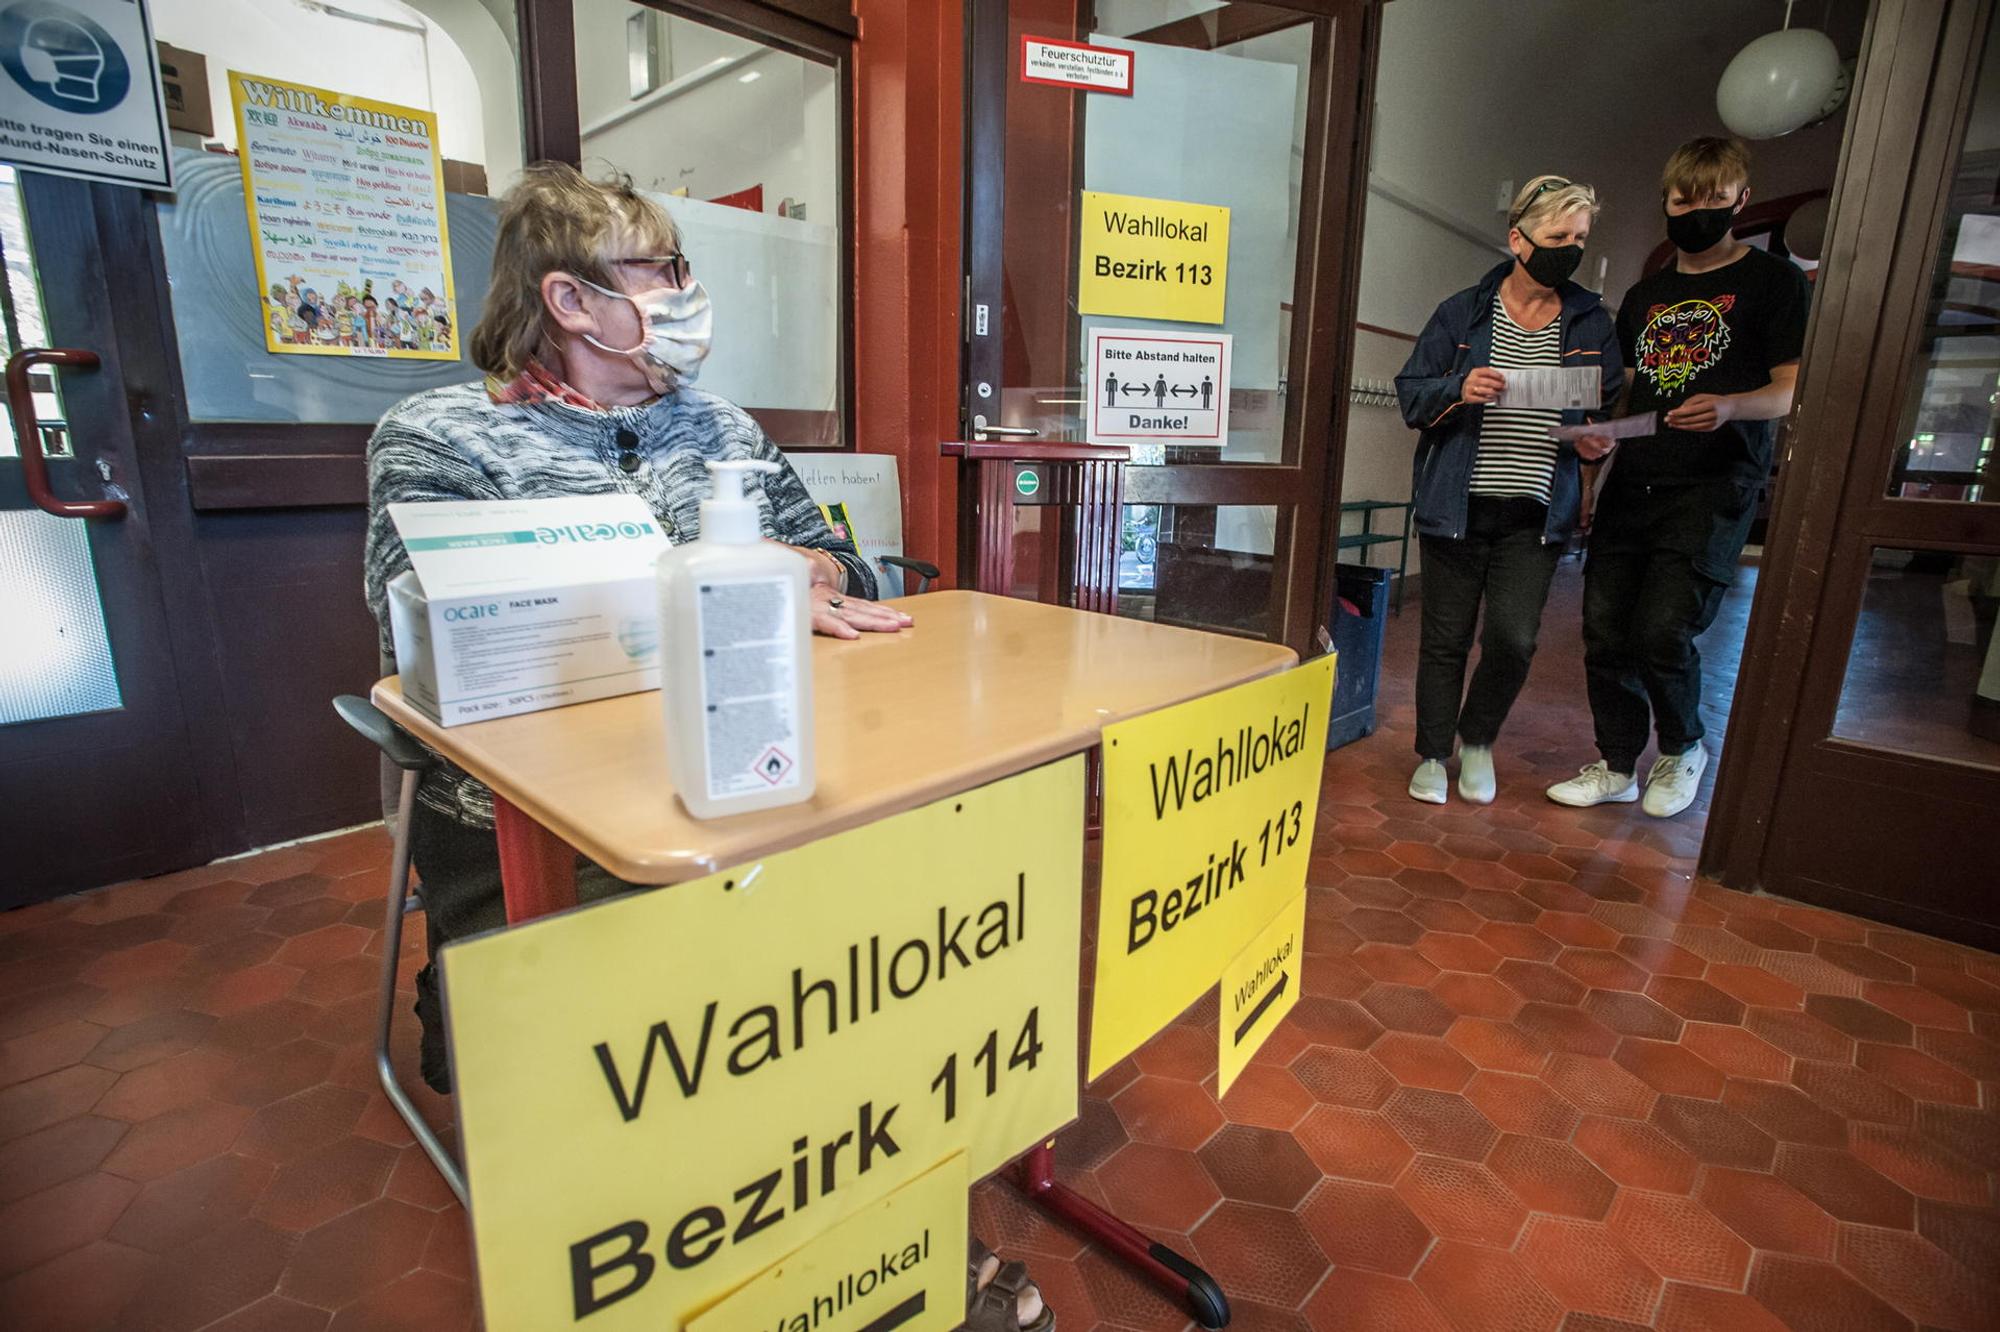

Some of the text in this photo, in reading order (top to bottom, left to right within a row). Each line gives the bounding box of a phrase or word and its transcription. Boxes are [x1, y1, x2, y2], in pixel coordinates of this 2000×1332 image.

[0, 117, 160, 155] itte tragen Sie einen
[240, 79, 429, 138] Willkommen
[1103, 210, 1208, 243] Wahllokal
[1095, 255, 1212, 286] Bezirk 113
[1105, 348, 1216, 364] Bitte Abstand halten
[1129, 414, 1189, 430] Danke!
[443, 597, 559, 622] ocare FACE MASK
[1149, 702, 1309, 821] Wahllokal
[1126, 799, 1304, 956] Bezirk 113
[593, 872, 1026, 1123] Wahllokal
[1234, 932, 1294, 1014] Wahllokal
[569, 1005, 1044, 1322] Bezirk 114
[763, 1228, 930, 1332] ahllokal
